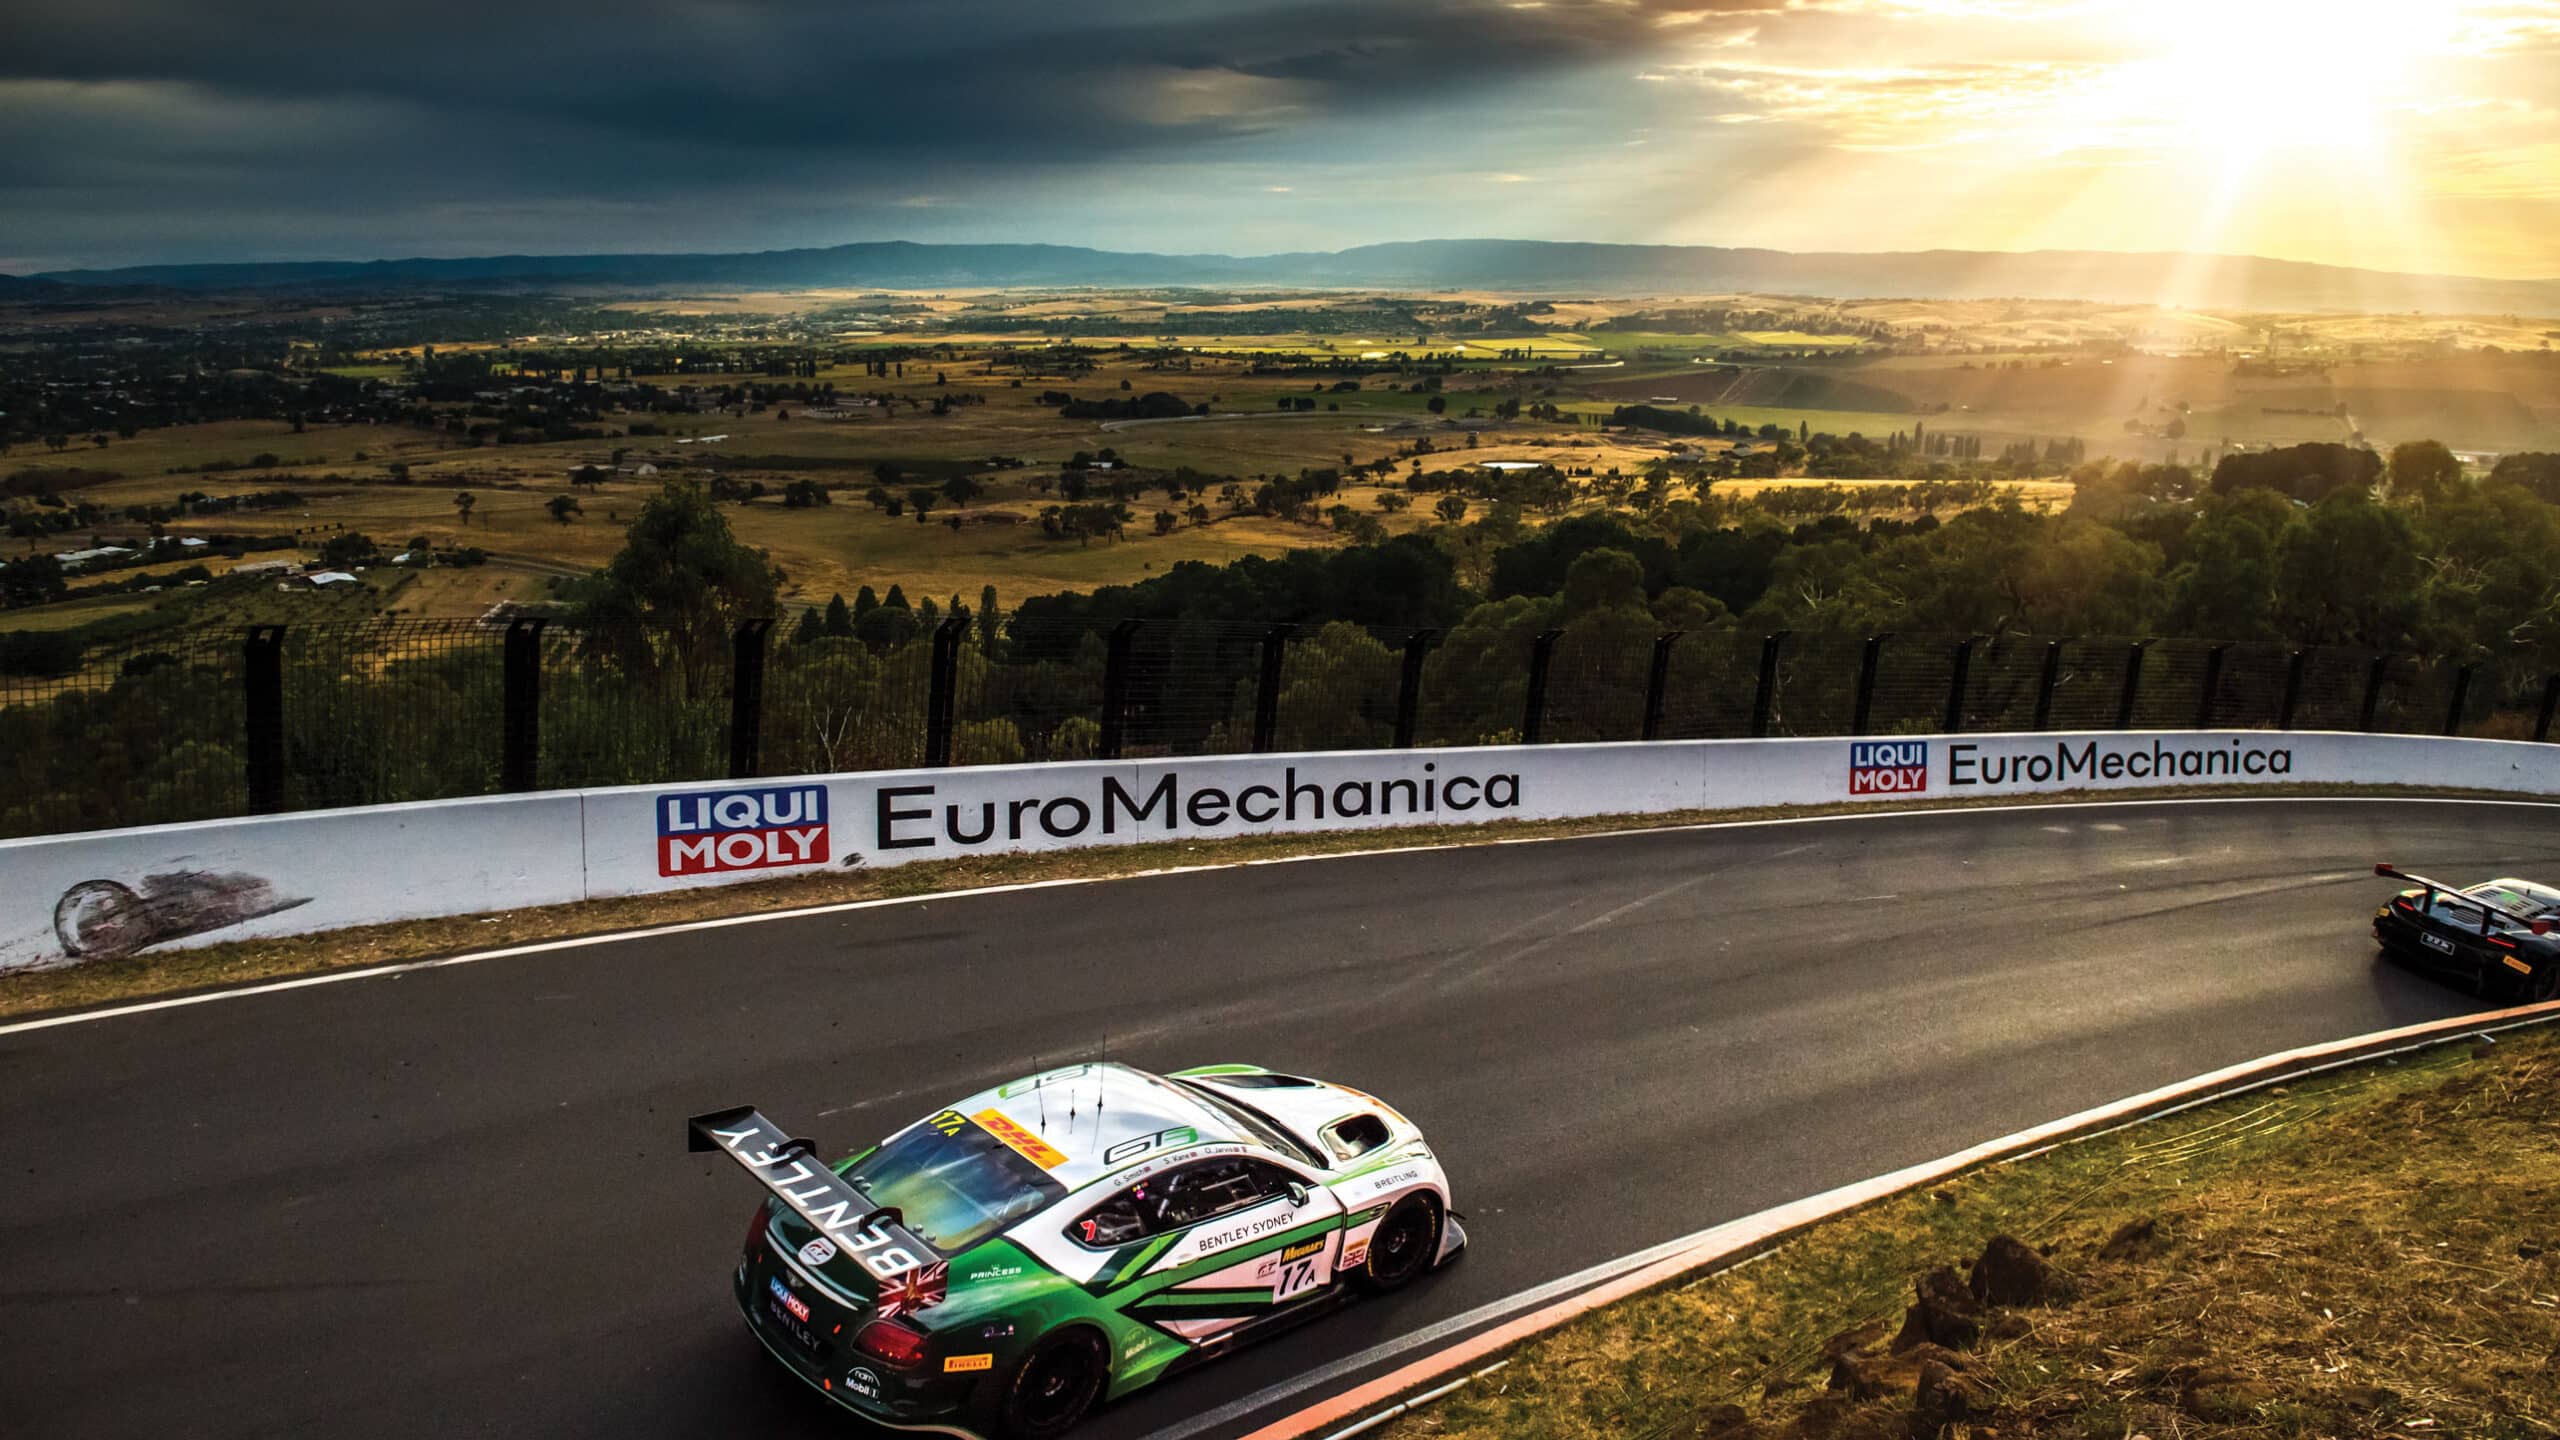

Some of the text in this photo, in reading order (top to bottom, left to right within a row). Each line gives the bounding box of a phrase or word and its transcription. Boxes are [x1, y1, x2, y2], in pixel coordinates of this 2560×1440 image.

[1855, 744, 1923, 767] LIQUI
[1949, 738, 2292, 785] EuroMechanica
[1854, 769, 1924, 792] MOLY
[668, 790, 818, 832] LIQUI
[876, 762, 1521, 850] EuroMechanica
[669, 827, 824, 871] MOLY
[983, 1117, 1049, 1160] DHL
[1103, 1124, 1199, 1165] GT3
[1374, 1170, 1418, 1189] BREITLING
[711, 1127, 922, 1277] BENTLEY
[1199, 1211, 1295, 1252] BENTLEY SYDNEY
[970, 1267, 1022, 1280] PRINCESS
[787, 1294, 810, 1321] MOLY
[845, 1377, 870, 1396] Mobil
